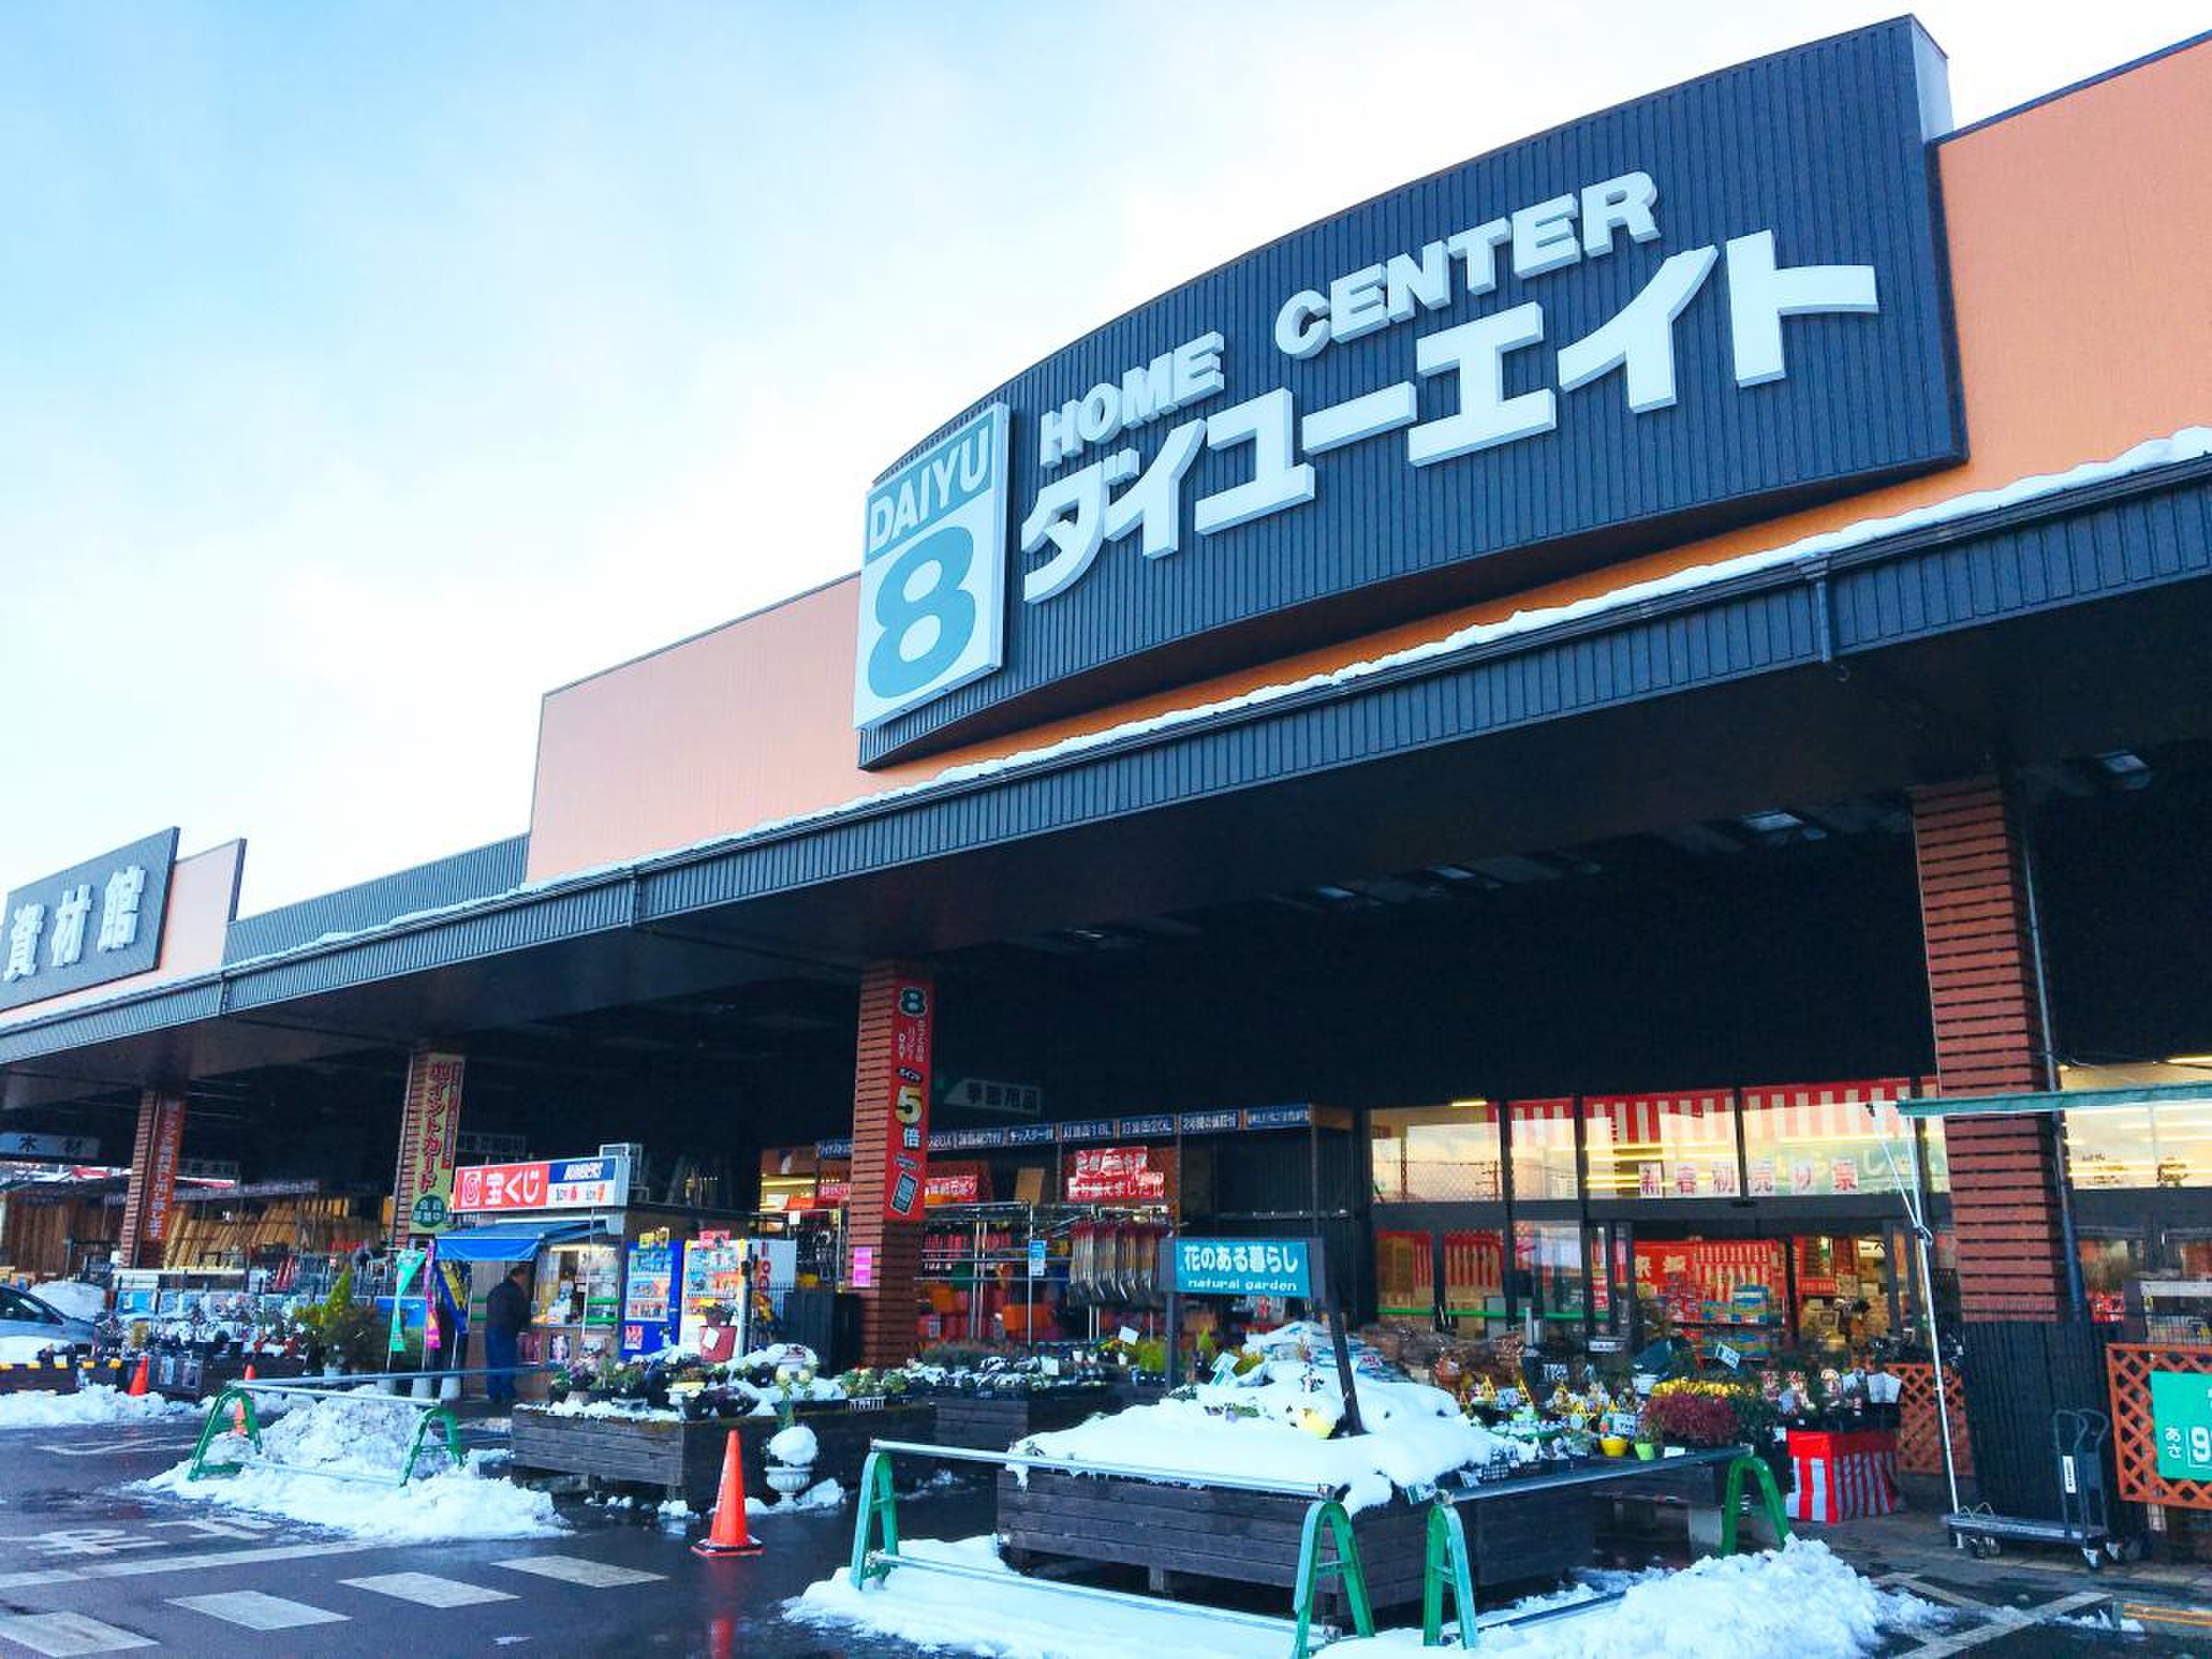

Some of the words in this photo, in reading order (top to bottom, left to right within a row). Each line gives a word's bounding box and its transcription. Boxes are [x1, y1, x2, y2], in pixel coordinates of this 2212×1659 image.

[1040, 331, 1225, 468] HOME
[1276, 171, 1660, 359] CENTER
[1020, 229, 1878, 606] ダイユーエイト
[869, 424, 990, 555] DAIYU
[868, 525, 976, 700] 8
[419, 1061, 452, 1195] ポイントカード
[485, 1170, 539, 1206] 宝くじ
[1183, 1244, 1299, 1273] 花のある暮らし
[1187, 1277, 1240, 1289] natural
[1244, 1278, 1298, 1291] garden
